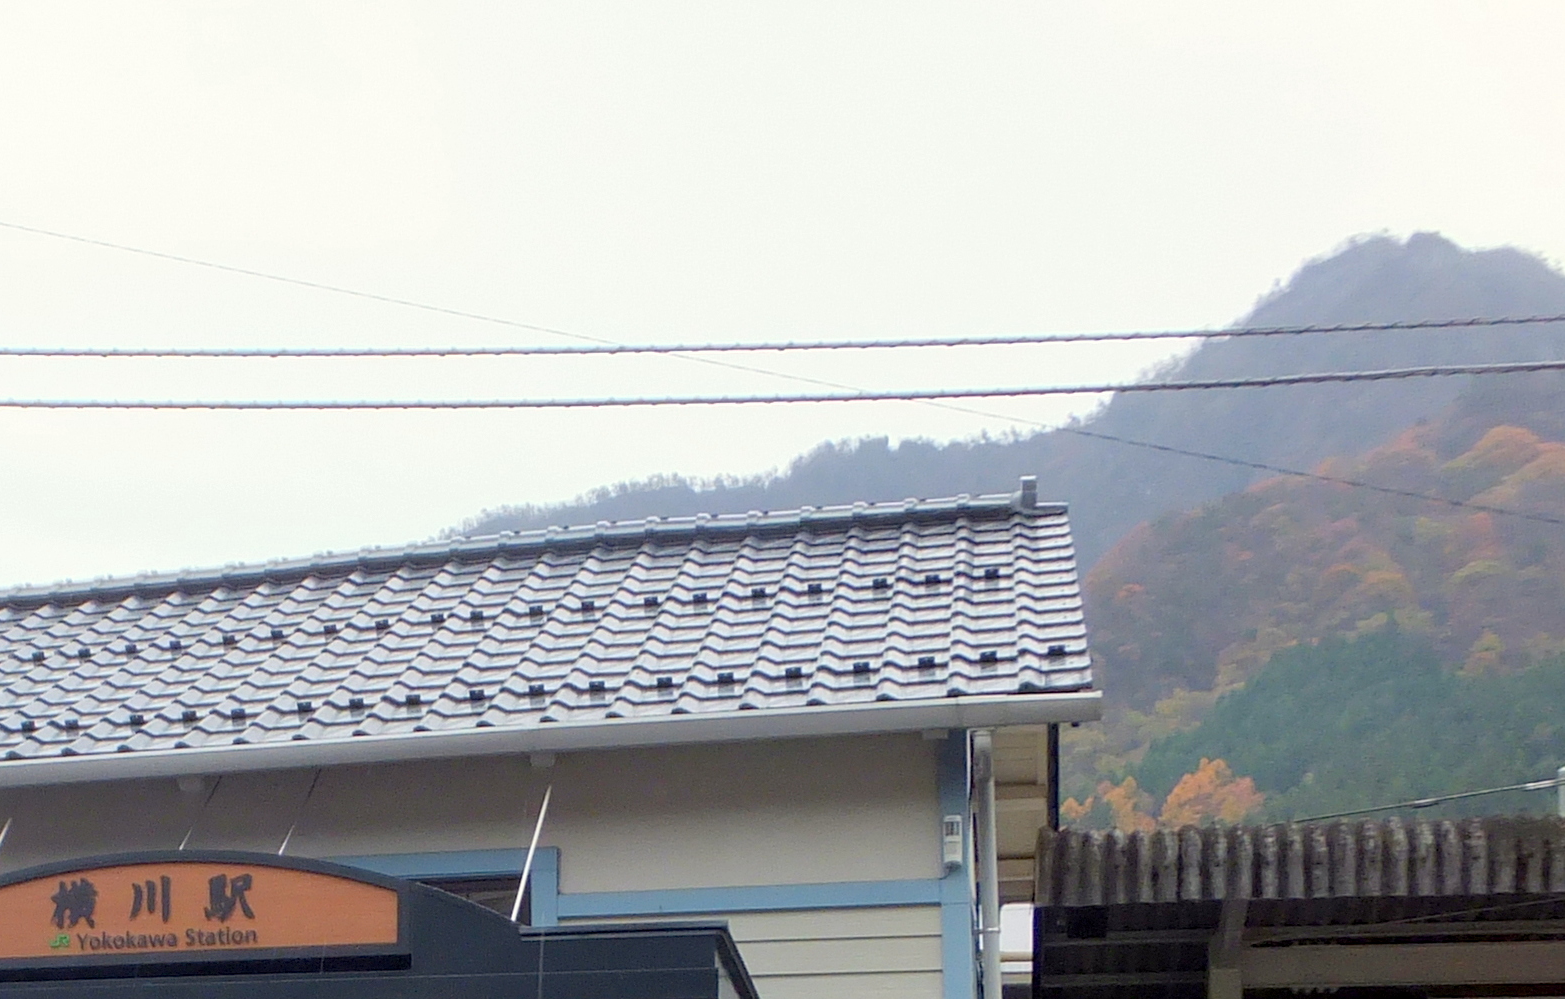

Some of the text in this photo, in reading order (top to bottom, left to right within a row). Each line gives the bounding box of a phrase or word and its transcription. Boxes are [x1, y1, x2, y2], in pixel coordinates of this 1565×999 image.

[50, 874, 256, 929] 横川駅
[49, 926, 258, 949] JR Yokokawa Station
